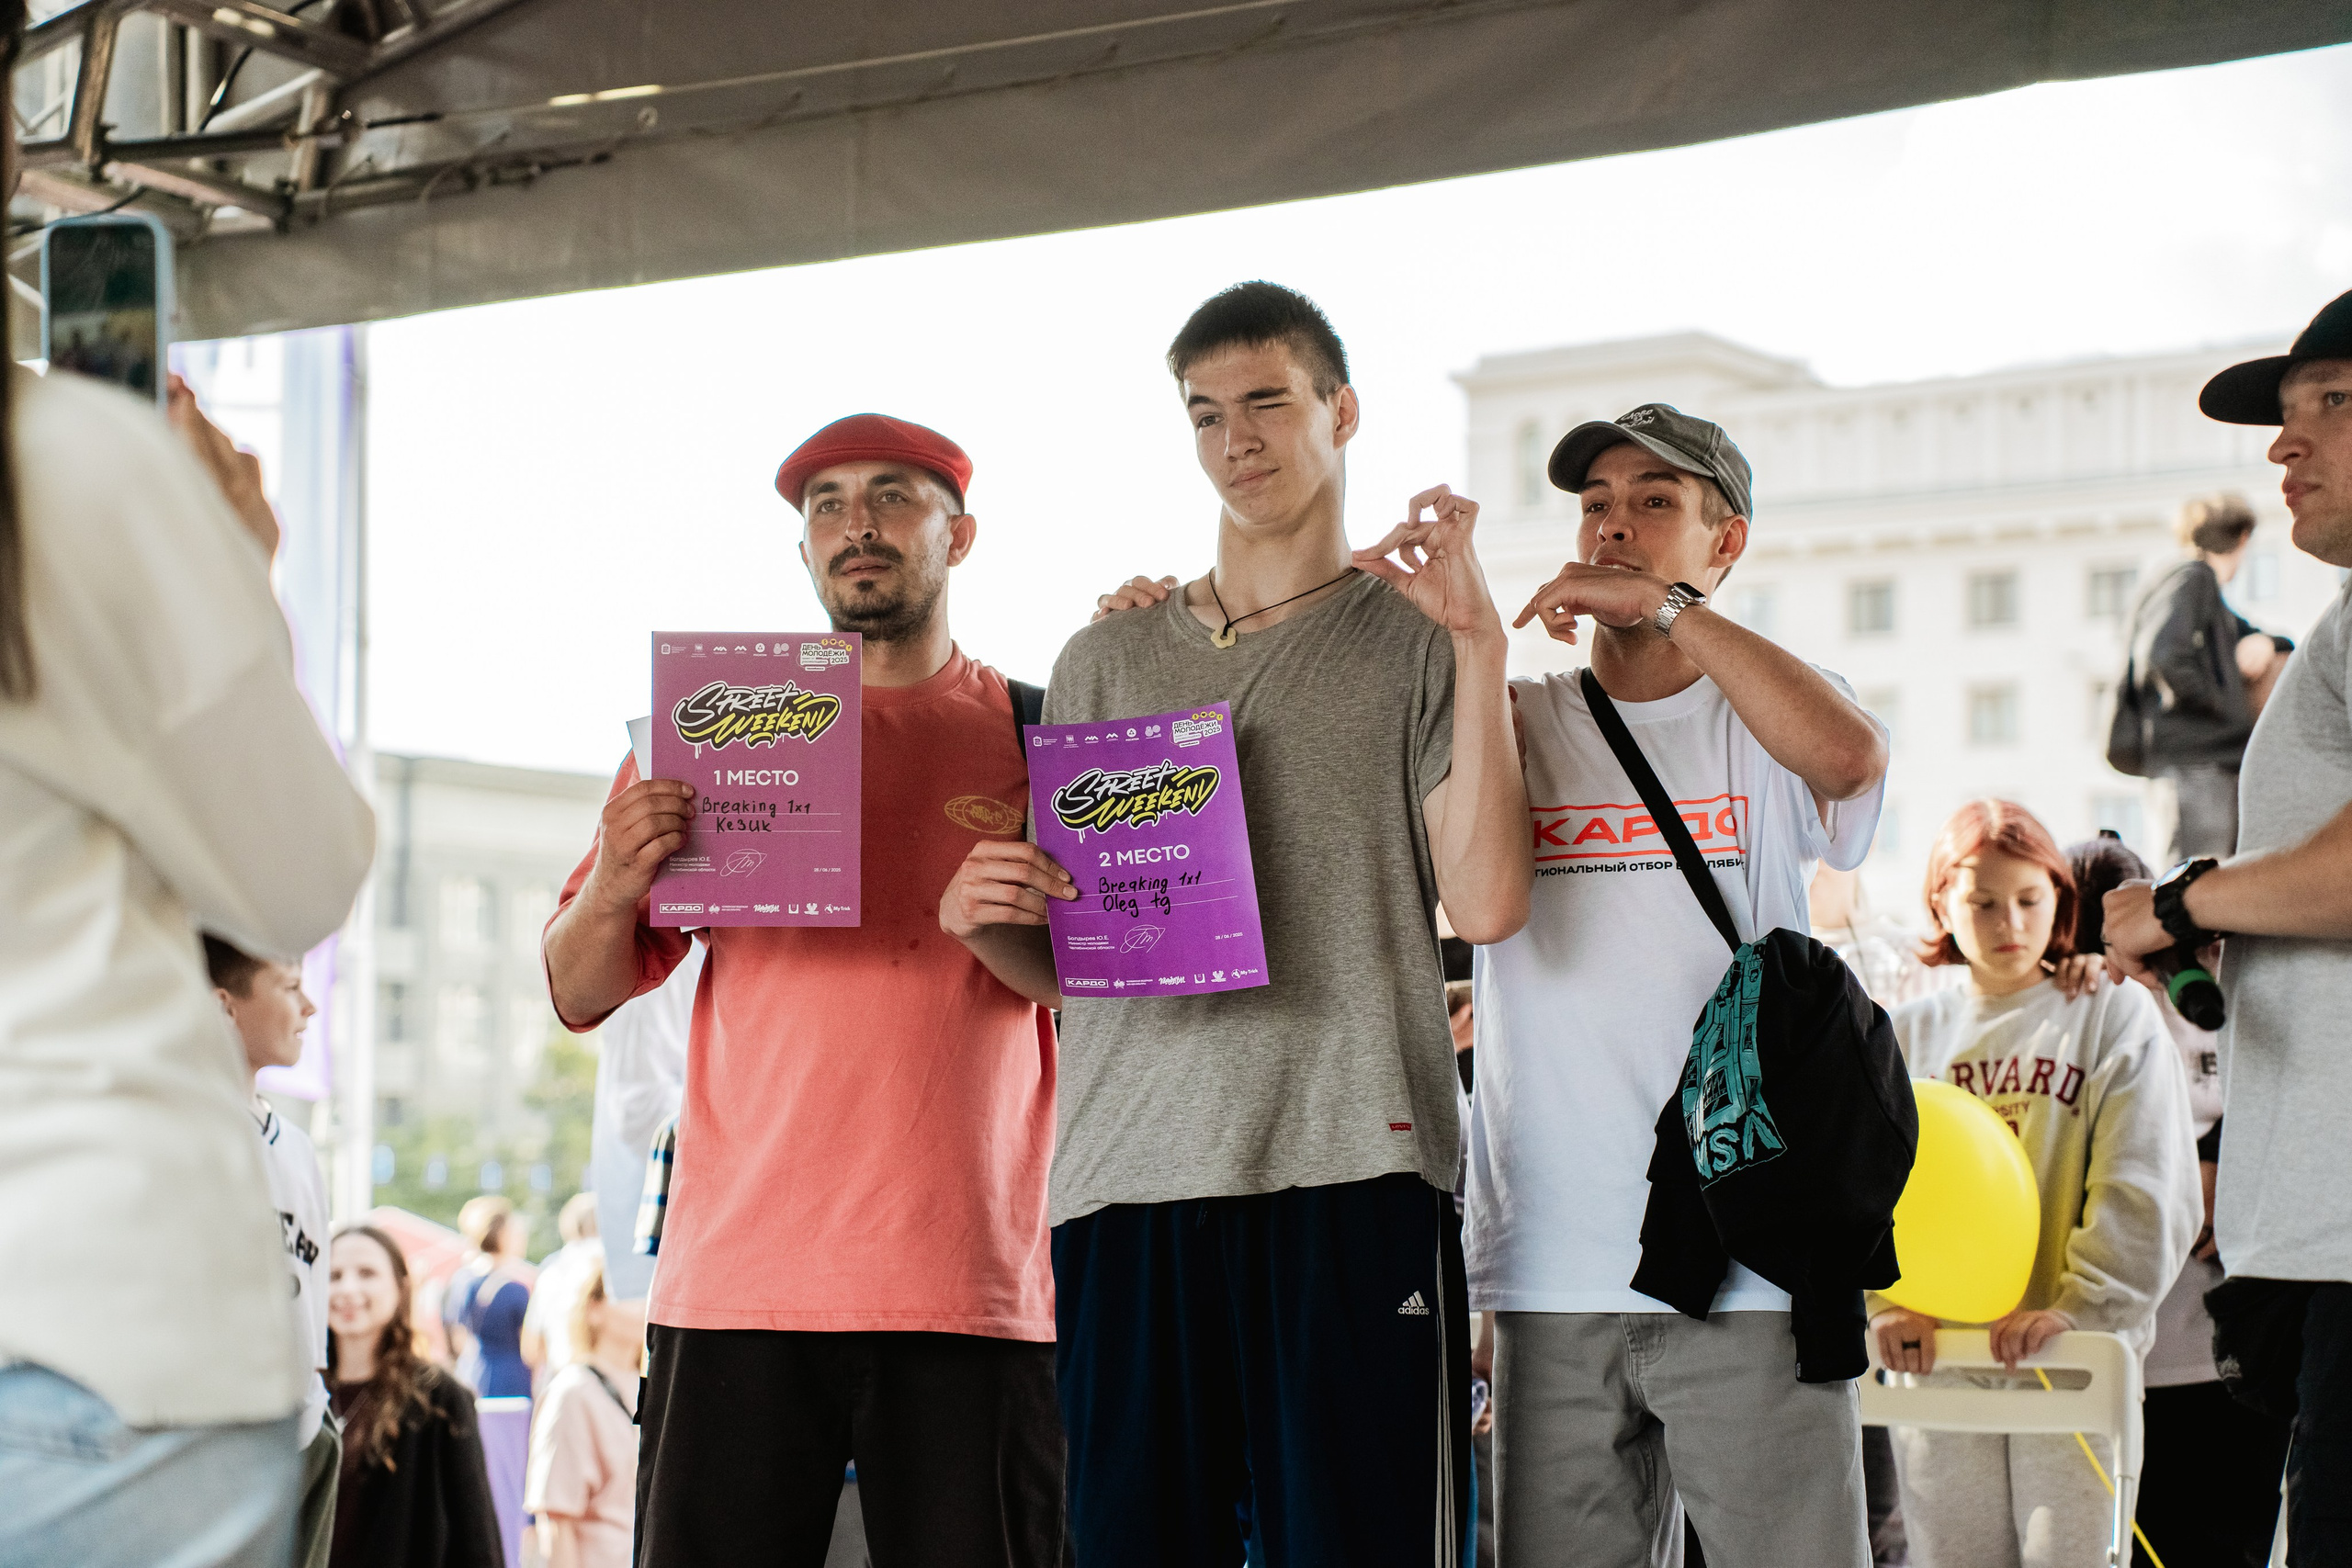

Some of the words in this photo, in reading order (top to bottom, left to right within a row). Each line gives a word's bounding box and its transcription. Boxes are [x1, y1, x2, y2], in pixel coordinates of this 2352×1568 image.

[675, 682, 798, 727] STREET
[681, 693, 839, 743] WEEKEND
[1204, 727, 1220, 735] 2025
[714, 771, 720, 784] 1
[728, 770, 799, 785] МЕСТО
[1056, 761, 1176, 813] STREET
[702, 797, 777, 818] Breaking
[1061, 768, 1217, 827] WEEKEND
[1533, 807, 1737, 849] КАРДО
[1099, 852, 1112, 867] 2
[1116, 844, 1190, 866] МЕСТО
[1629, 861, 1673, 872] ОТБОР
[1099, 875, 1169, 895] Breaking
[1102, 894, 1139, 918] Oleg
[1951, 1056, 2086, 1106] RVARD
[1397, 1306, 1430, 1315] adidas
